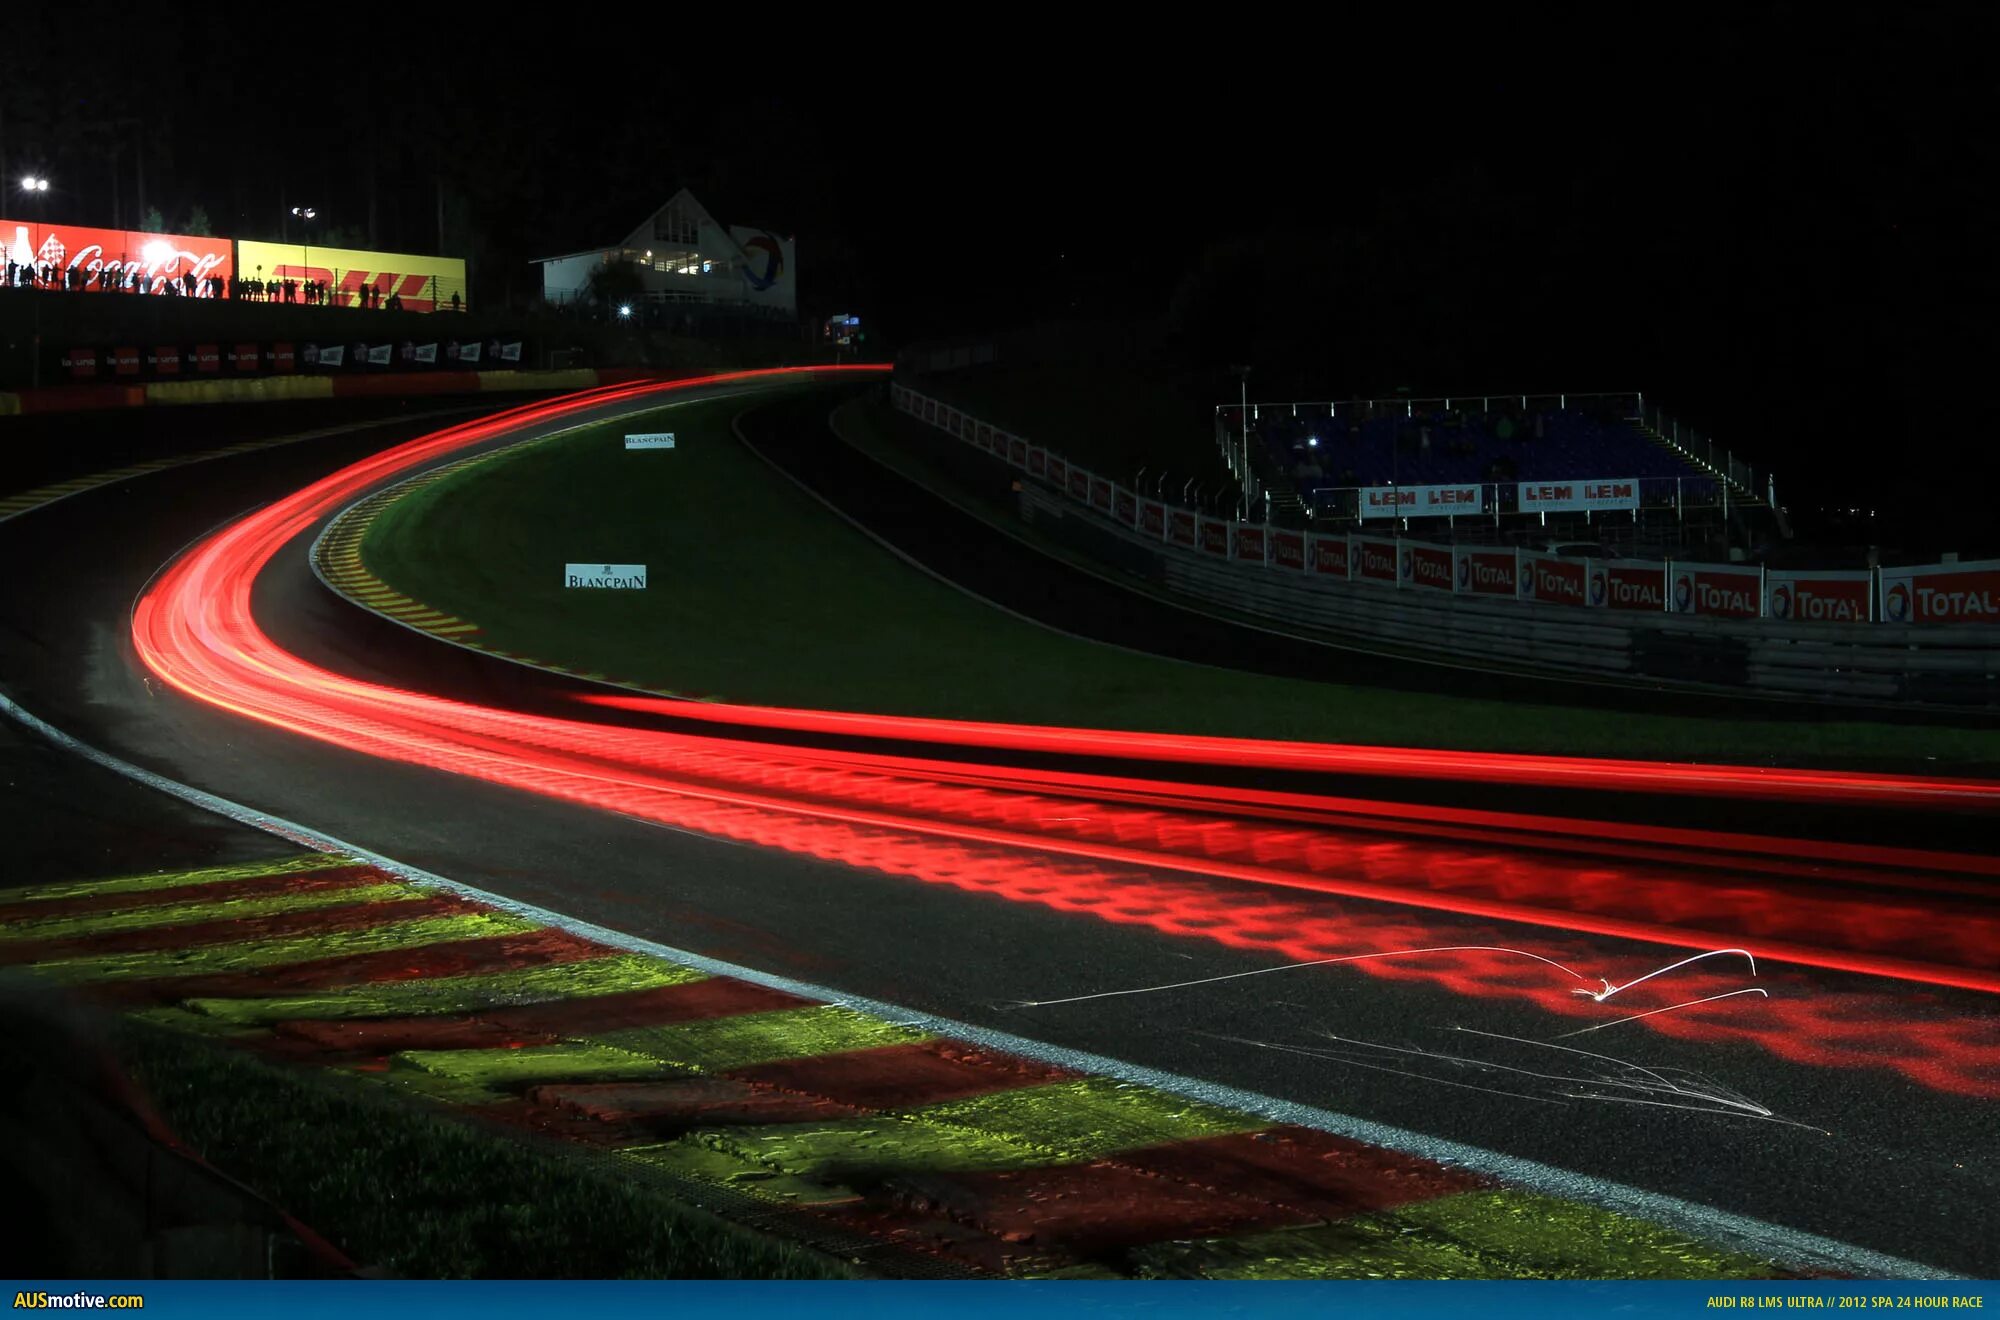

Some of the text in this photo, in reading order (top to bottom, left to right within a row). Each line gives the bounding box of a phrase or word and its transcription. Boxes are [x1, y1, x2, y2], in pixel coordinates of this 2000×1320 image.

[272, 264, 436, 313] DHL
[625, 436, 674, 444] BLANCPAIN
[1369, 489, 1475, 506] LEM LEM
[1526, 484, 1633, 500] LEM LEM
[1318, 547, 1347, 569] TOTAL
[1363, 550, 1396, 573] TOTAL
[1414, 556, 1451, 582] TOTAL
[569, 575, 645, 590] BLANCPAIN
[1472, 562, 1514, 585] TOTAL
[1537, 568, 1583, 598] TOTAL
[1610, 578, 1664, 605] TOTAL
[1697, 582, 1756, 613] TOTAL
[1916, 587, 1999, 616] TOTAL
[1796, 591, 1869, 621] TOTAL
